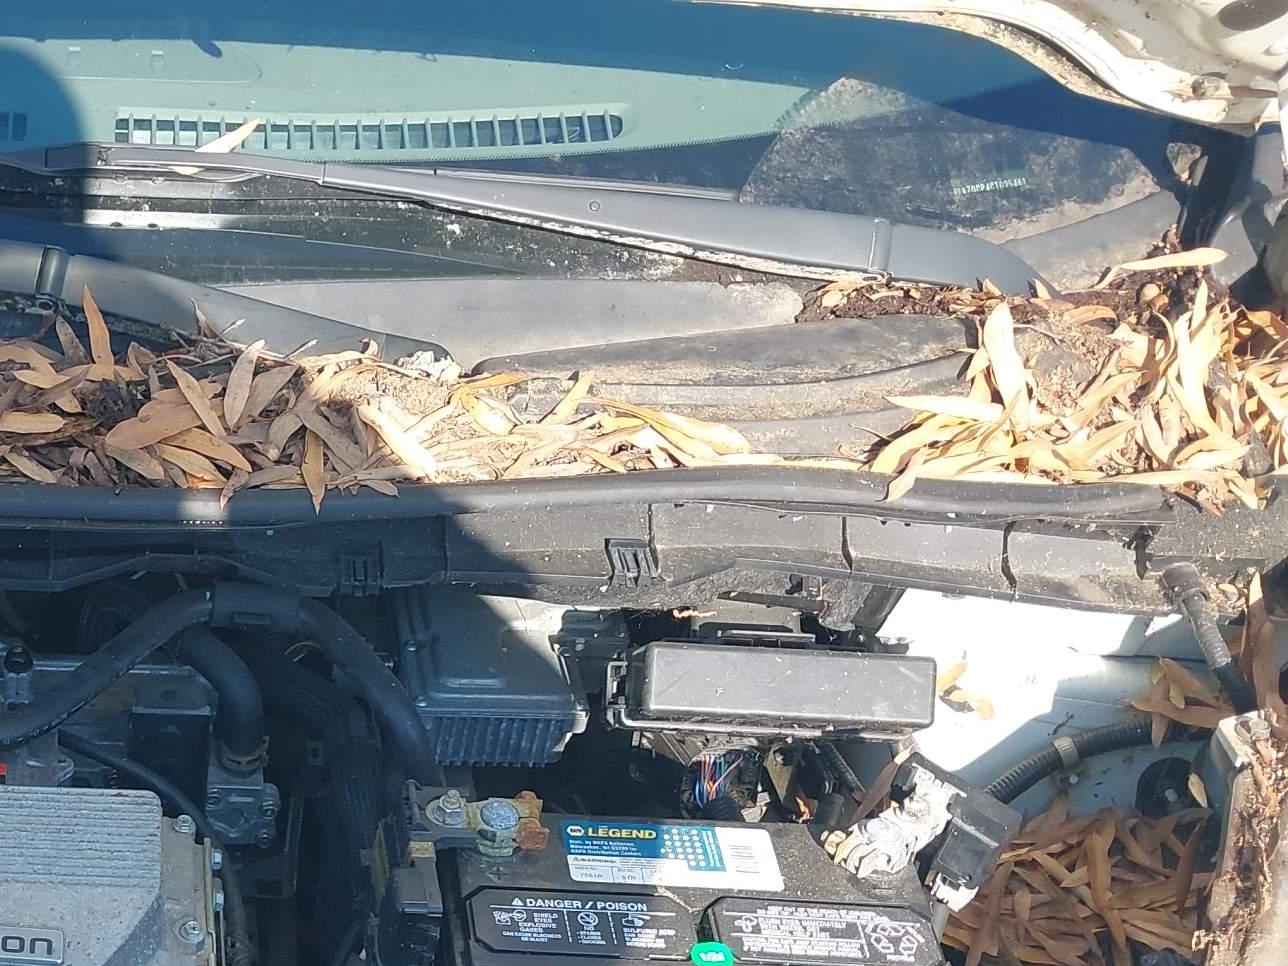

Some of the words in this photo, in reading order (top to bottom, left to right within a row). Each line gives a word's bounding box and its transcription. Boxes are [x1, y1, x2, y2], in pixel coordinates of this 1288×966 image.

[587, 827, 657, 839] LEGEND
[526, 898, 582, 909] DANGER
[584, 901, 595, 910] /
[597, 902, 647, 911] POISON
